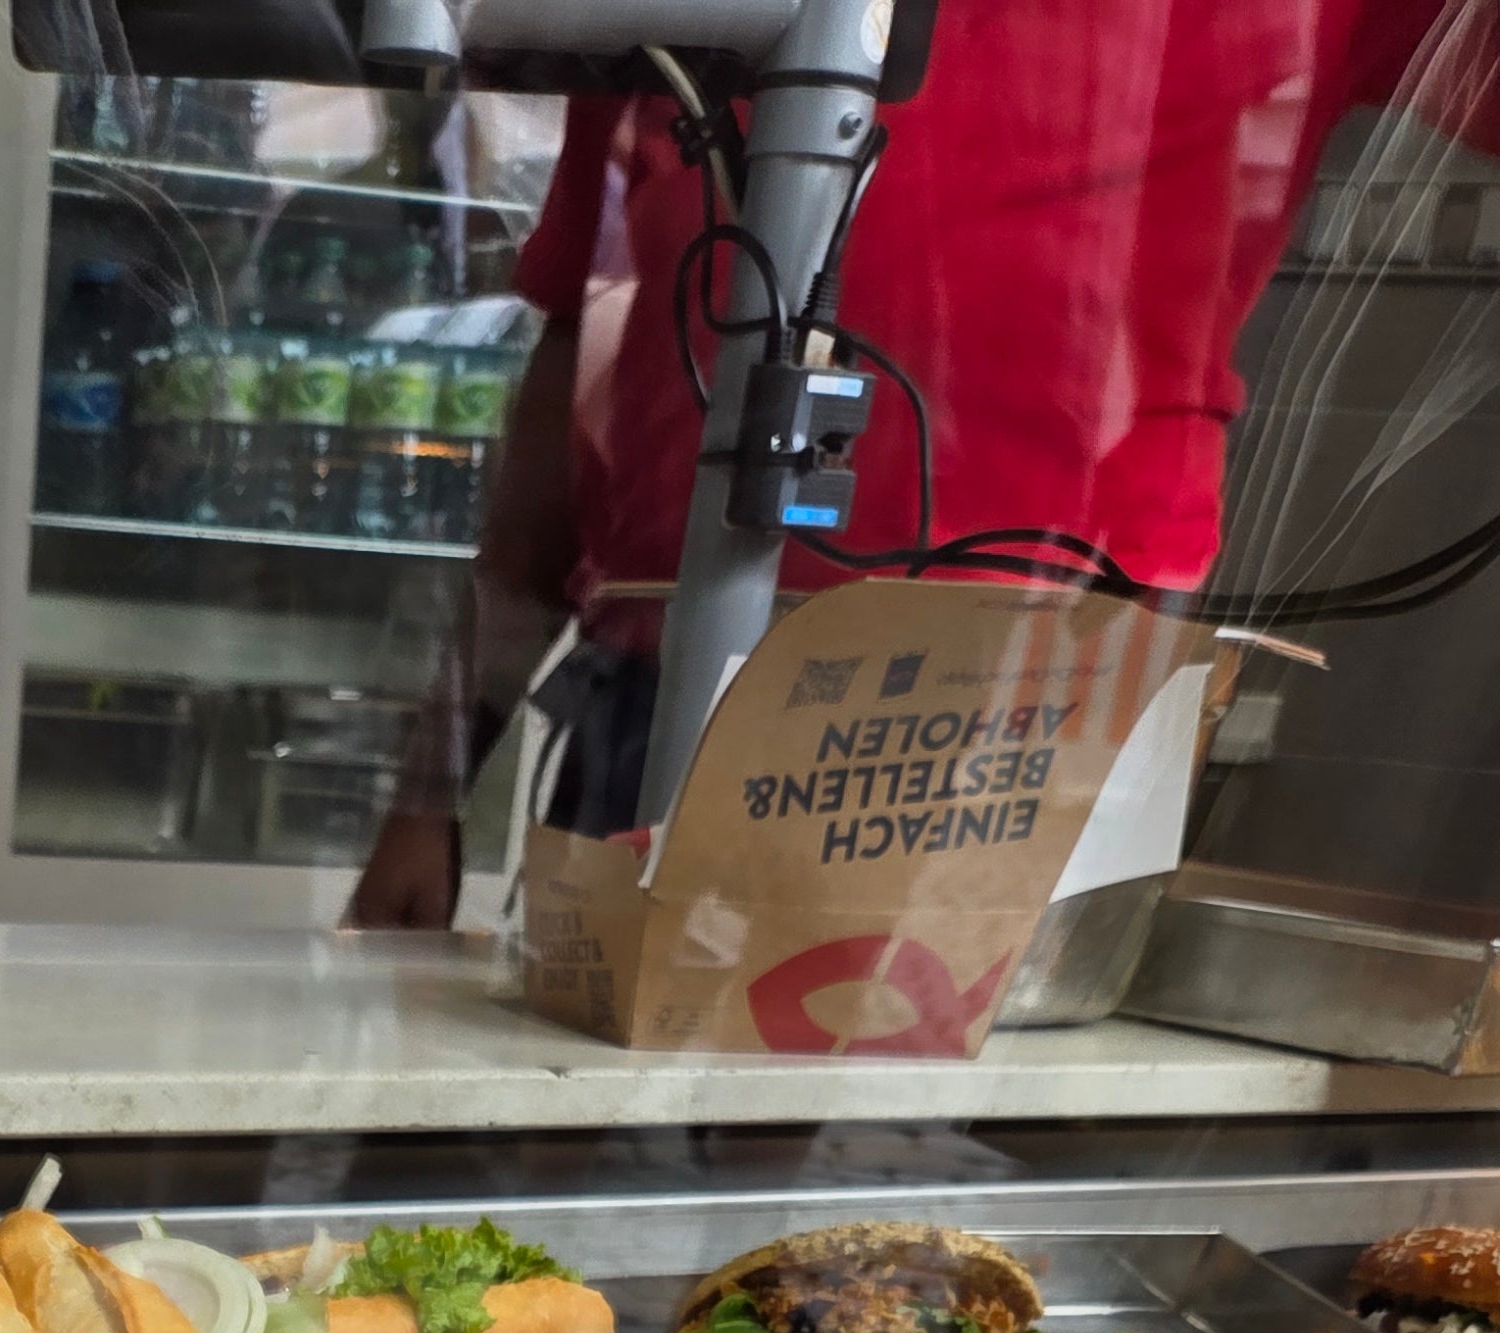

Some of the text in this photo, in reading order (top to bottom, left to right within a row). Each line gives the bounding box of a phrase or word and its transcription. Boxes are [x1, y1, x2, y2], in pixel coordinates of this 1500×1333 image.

[816, 702, 1079, 763] ABHOLEN
[743, 748, 1056, 821] BESTELLEN&
[820, 799, 1040, 865] EINFACH
